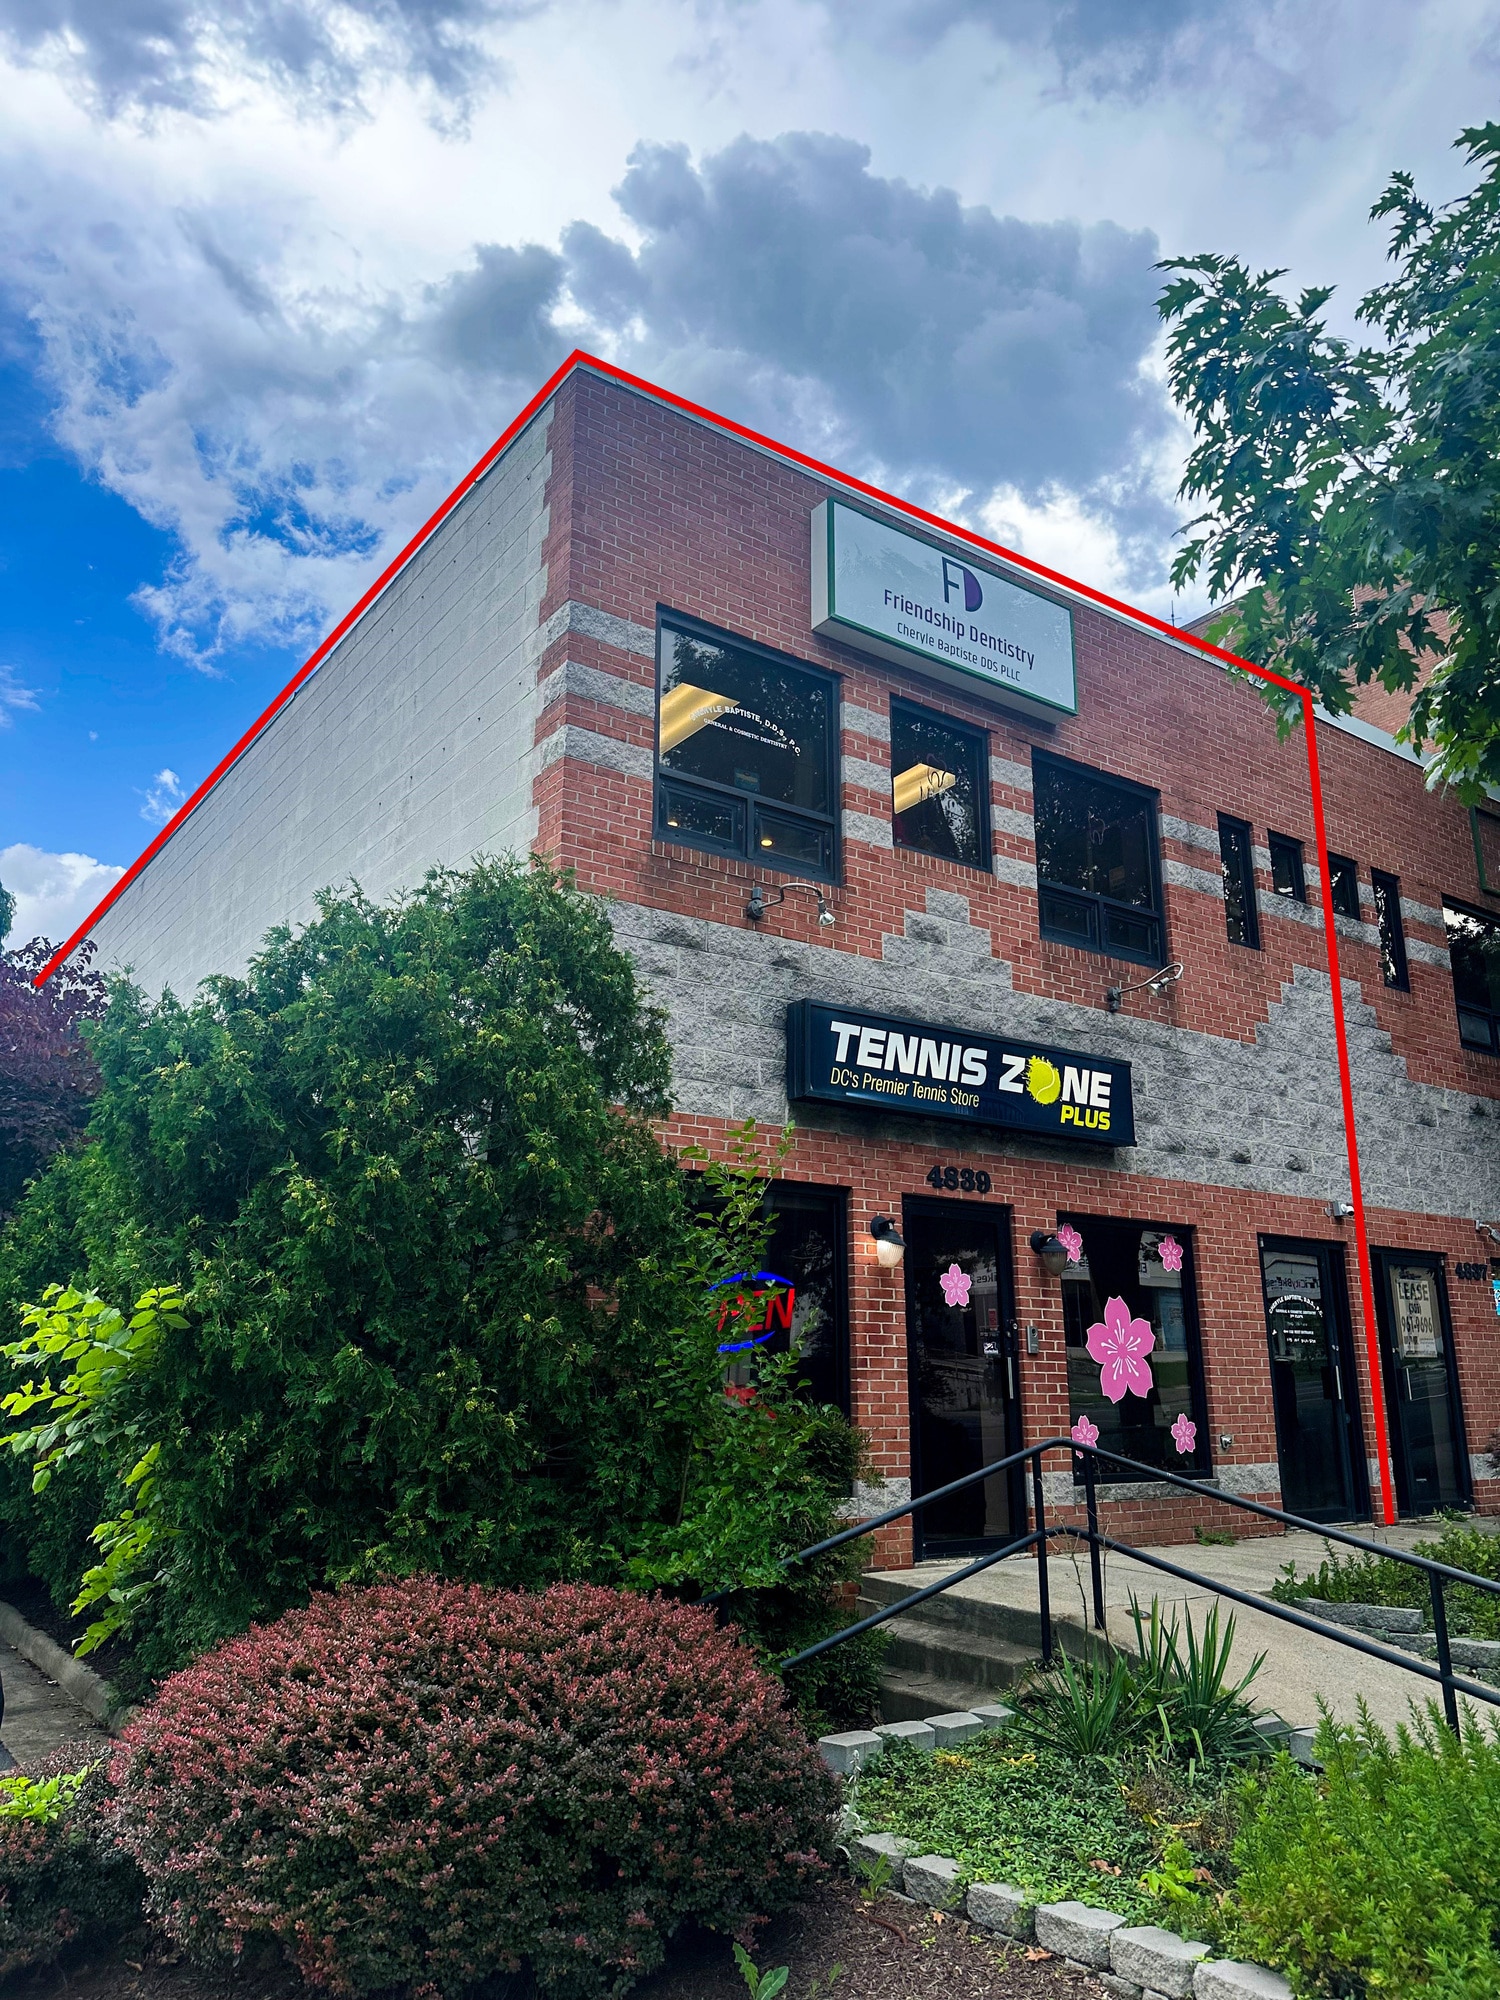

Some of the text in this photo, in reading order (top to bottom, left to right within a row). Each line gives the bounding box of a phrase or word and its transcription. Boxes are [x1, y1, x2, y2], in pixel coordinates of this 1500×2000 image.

[884, 589, 1035, 670] Friendship Dentistry
[897, 622, 1021, 682] Cheryle Baptiste DDS PLLC
[703, 717, 728, 730] GENERAL
[733, 727, 760, 741] COSMETIC
[760, 736, 788, 750] DENTISTRY
[724, 706, 763, 725] BAPTISTE,
[788, 738, 801, 757] P.C.
[830, 1020, 989, 1087] TENNIS
[830, 1067, 980, 1108] DC's Premier Tennis Store
[1060, 1104, 1111, 1131] PLUS
[926, 1164, 992, 1194] 4839
[1398, 1282, 1429, 1301] LEASE
